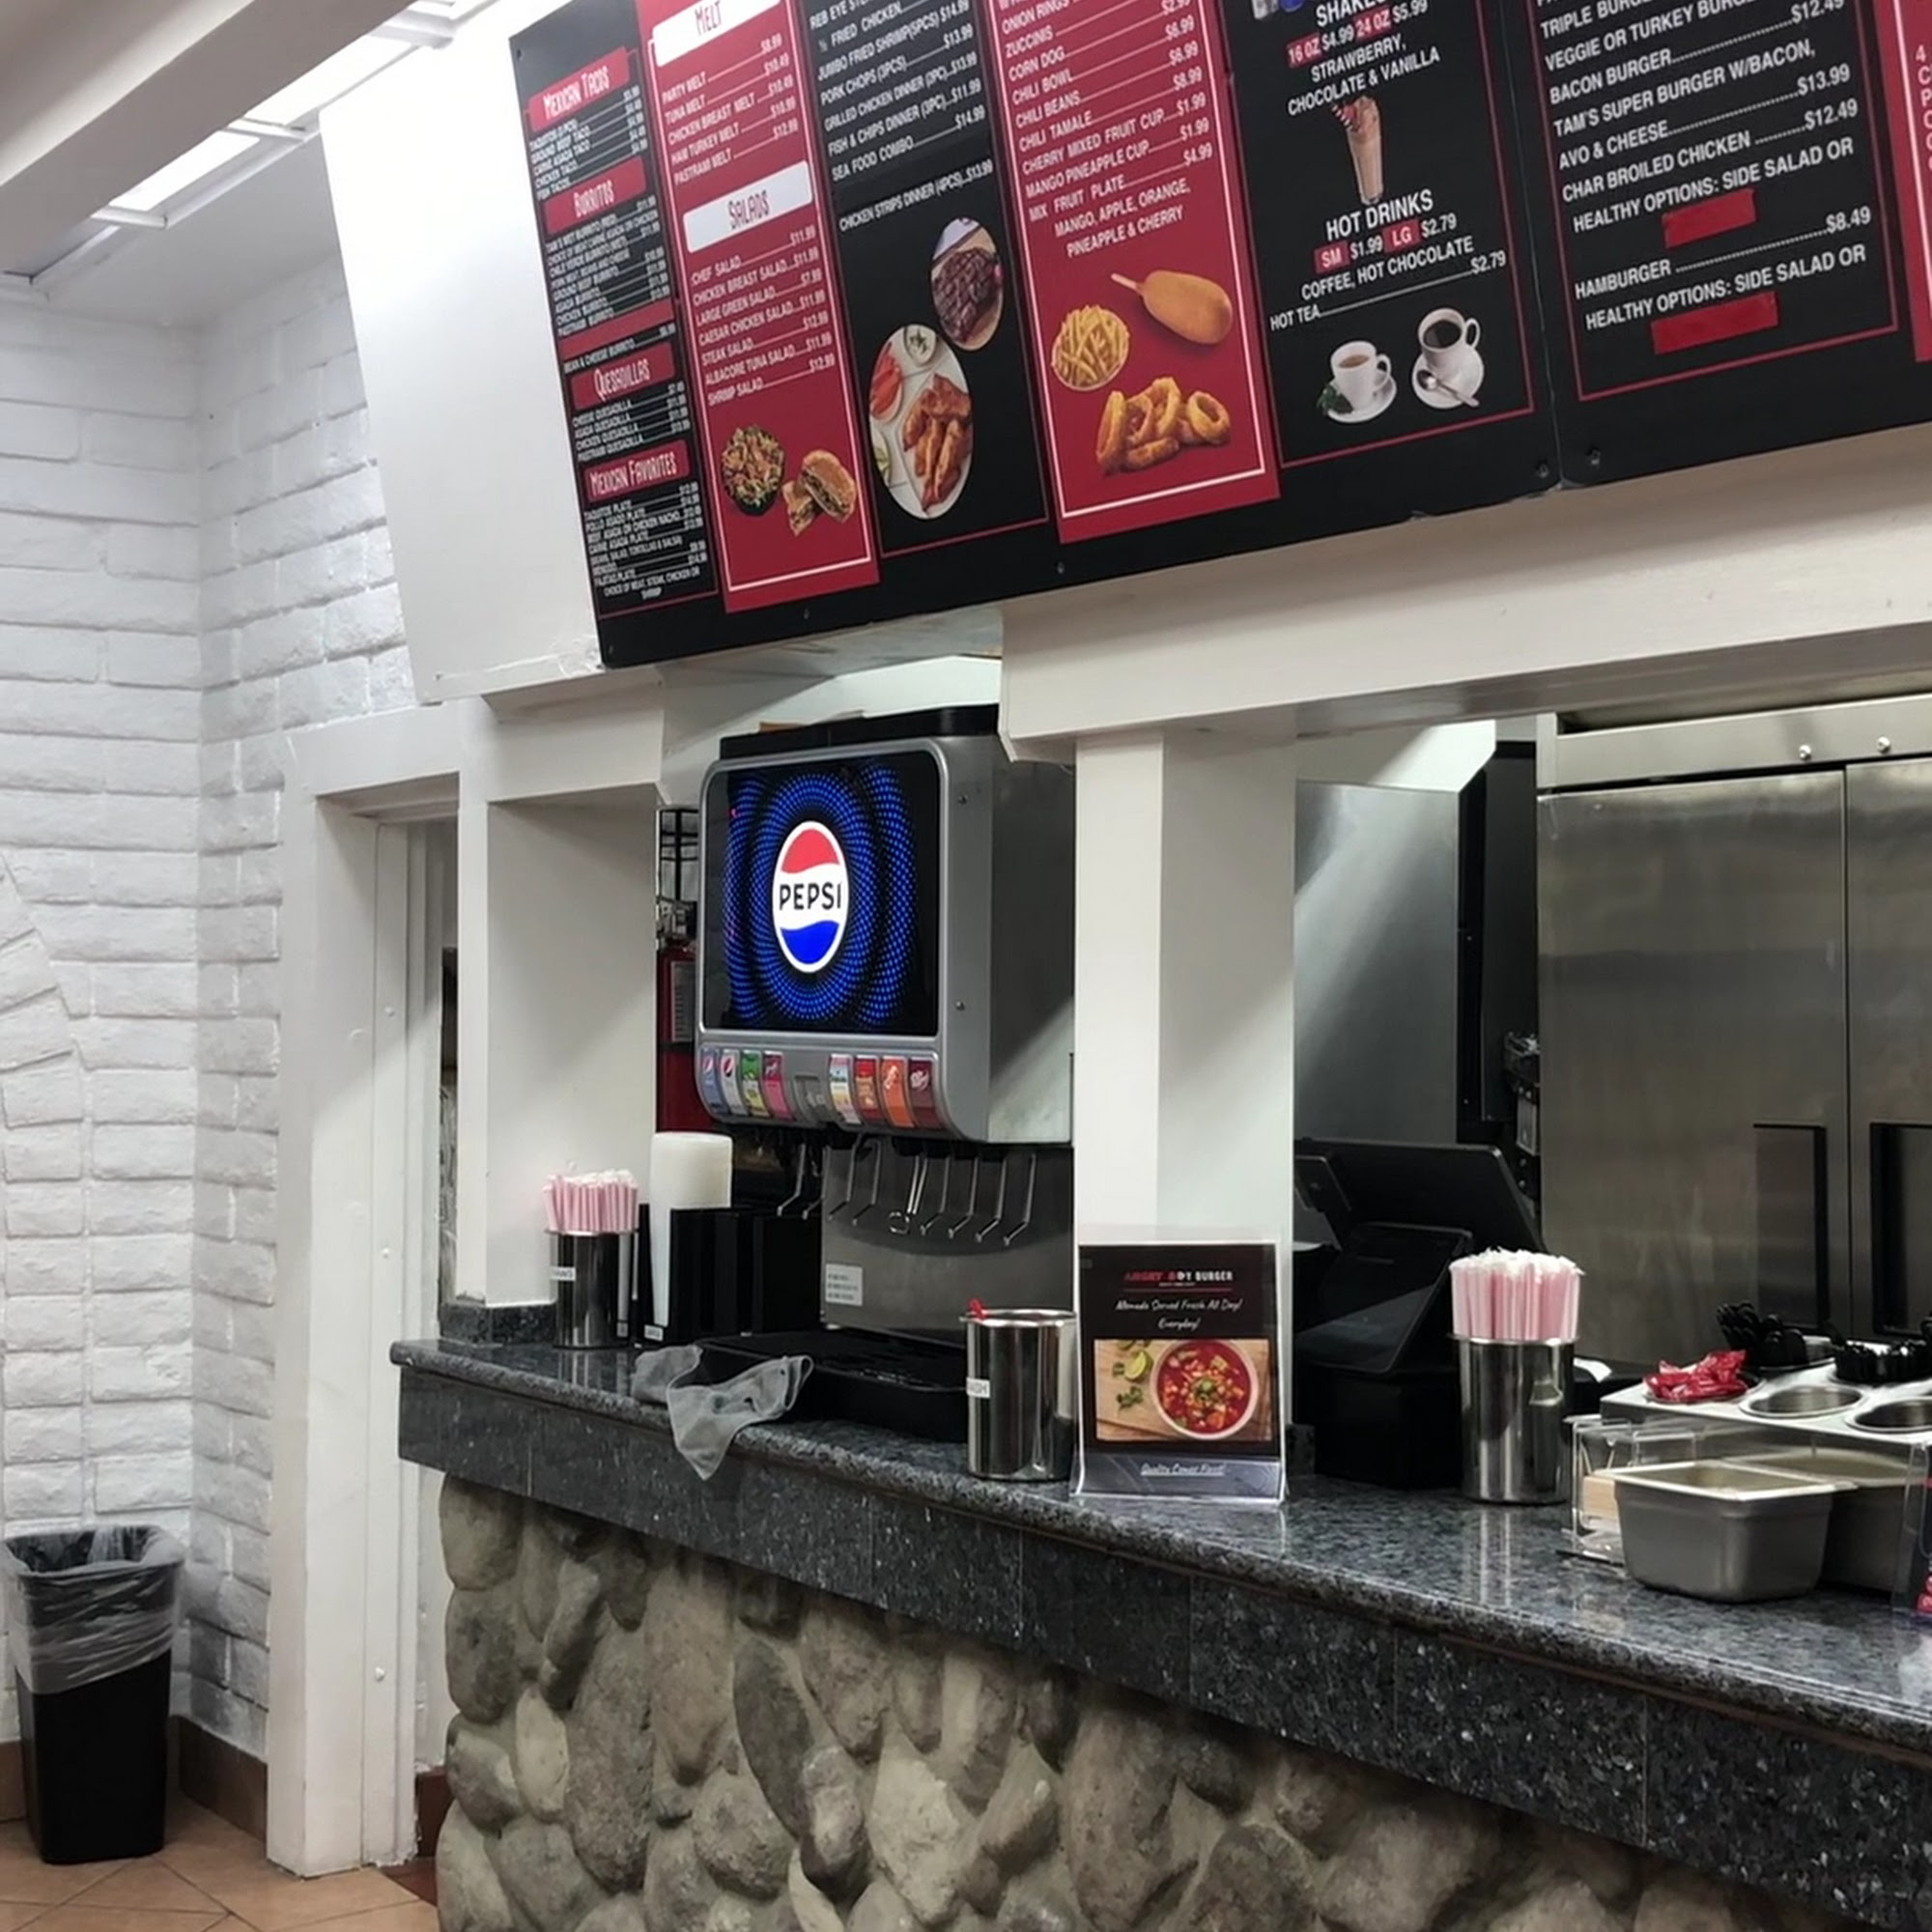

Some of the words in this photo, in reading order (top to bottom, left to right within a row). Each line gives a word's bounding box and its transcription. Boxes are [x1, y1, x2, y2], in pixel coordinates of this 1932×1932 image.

[694, 0, 723, 36] MELT
[1002, 8, 1036, 35] ONION
[1289, 44, 1303, 63] 16
[1304, 38, 1321, 58] OZ
[1321, 24, 1354, 51] $4.99
[1355, 17, 1372, 38] 24
[1373, 9, 1391, 30] OZ
[1392, 0, 1428, 23] $5.99
[1316, 0, 1383, 27] SHAK
[1540, 6, 1593, 39] TRIPLE
[1545, 38, 1601, 71] VEGGIE
[1604, 28, 1627, 51] OR
[1629, 4, 1693, 41] TURKEY
[818, 55, 848, 81] JUMBO
[1009, 57, 1039, 81] CORN
[1040, 45, 1065, 68] DOG
[1288, 72, 1366, 116] CHOCOLATE
[1369, 69, 1378, 86] &
[1380, 46, 1440, 80] VANILLA
[1311, 33, 1406, 82] STRAWBERRY,
[1549, 71, 1603, 104] BACON
[1605, 48, 1673, 85] BURGER
[1012, 82, 1039, 105] CHILI
[1041, 69, 1074, 93] BOWL
[1015, 105, 1043, 128] CHILI
[1043, 90, 1082, 117] BEANS
[1553, 108, 1600, 136] TAM'S
[1602, 90, 1654, 122] SUPER
[1657, 67, 1725, 103] BURGER
[1728, 39, 1815, 79] W/BACON,
[1019, 129, 1046, 152] CHILI
[1049, 110, 1094, 139] TAMALE
[1022, 147, 1064, 175] CHERRY
[1067, 133, 1101, 157] MIXED
[1105, 118, 1136, 143] FRUIT
[1177, 92, 1206, 116] $1.99
[1559, 145, 1590, 169] AVO
[1593, 141, 1604, 158] &
[1606, 120, 1670, 155] CHEESE
[1797, 63, 1850, 96] $13.99
[1025, 172, 1065, 198] MANGO
[1065, 149, 1124, 184] PINEAPPLE
[1179, 117, 1209, 141] $1.99
[1562, 175, 1605, 202] CHAR
[1606, 154, 1674, 188] BROILED
[1677, 130, 1750, 167] CHICKEN
[1804, 98, 1858, 130] $12.49
[1029, 203, 1048, 221] MIX
[1054, 189, 1084, 213] FRUIT
[1091, 174, 1126, 199] PLATE
[1183, 142, 1212, 166] $4.99
[1574, 198, 1640, 233] HEALTHY
[1644, 177, 1719, 212] OPTIONS:
[1721, 163, 1761, 189] SIDE
[1764, 146, 1823, 178] SALAD
[1827, 137, 1854, 159] OR
[1066, 224, 1126, 258] PINEAPPLE
[1127, 222, 1136, 238] &
[1137, 205, 1182, 234] CHERRY
[1321, 247, 1342, 268] SM
[1350, 235, 1383, 260] $1.99
[1392, 226, 1412, 246] LG
[1421, 213, 1457, 238] $2.79
[1326, 211, 1361, 241] HOT
[1365, 188, 1434, 229] DRINKS
[1301, 271, 1355, 300] COFFEE,
[1357, 261, 1384, 284] HOT
[1387, 236, 1474, 275] CHOCOLATE
[1575, 259, 1671, 299] HAMBURGER
[1826, 206, 1871, 234] $8.49
[1270, 310, 1293, 330] HOT
[1296, 304, 1321, 323] TEA
[1470, 250, 1506, 274] $2.79
[1585, 298, 1653, 329] HEALTHY
[1657, 279, 1731, 312] OPTIONS:
[1734, 267, 1774, 293] SIDE
[1776, 251, 1835, 282] SALAD
[1838, 243, 1865, 266] OR
[779, 882, 842, 910] PEPSI
[1195, 1270, 1234, 1282] BURGER
